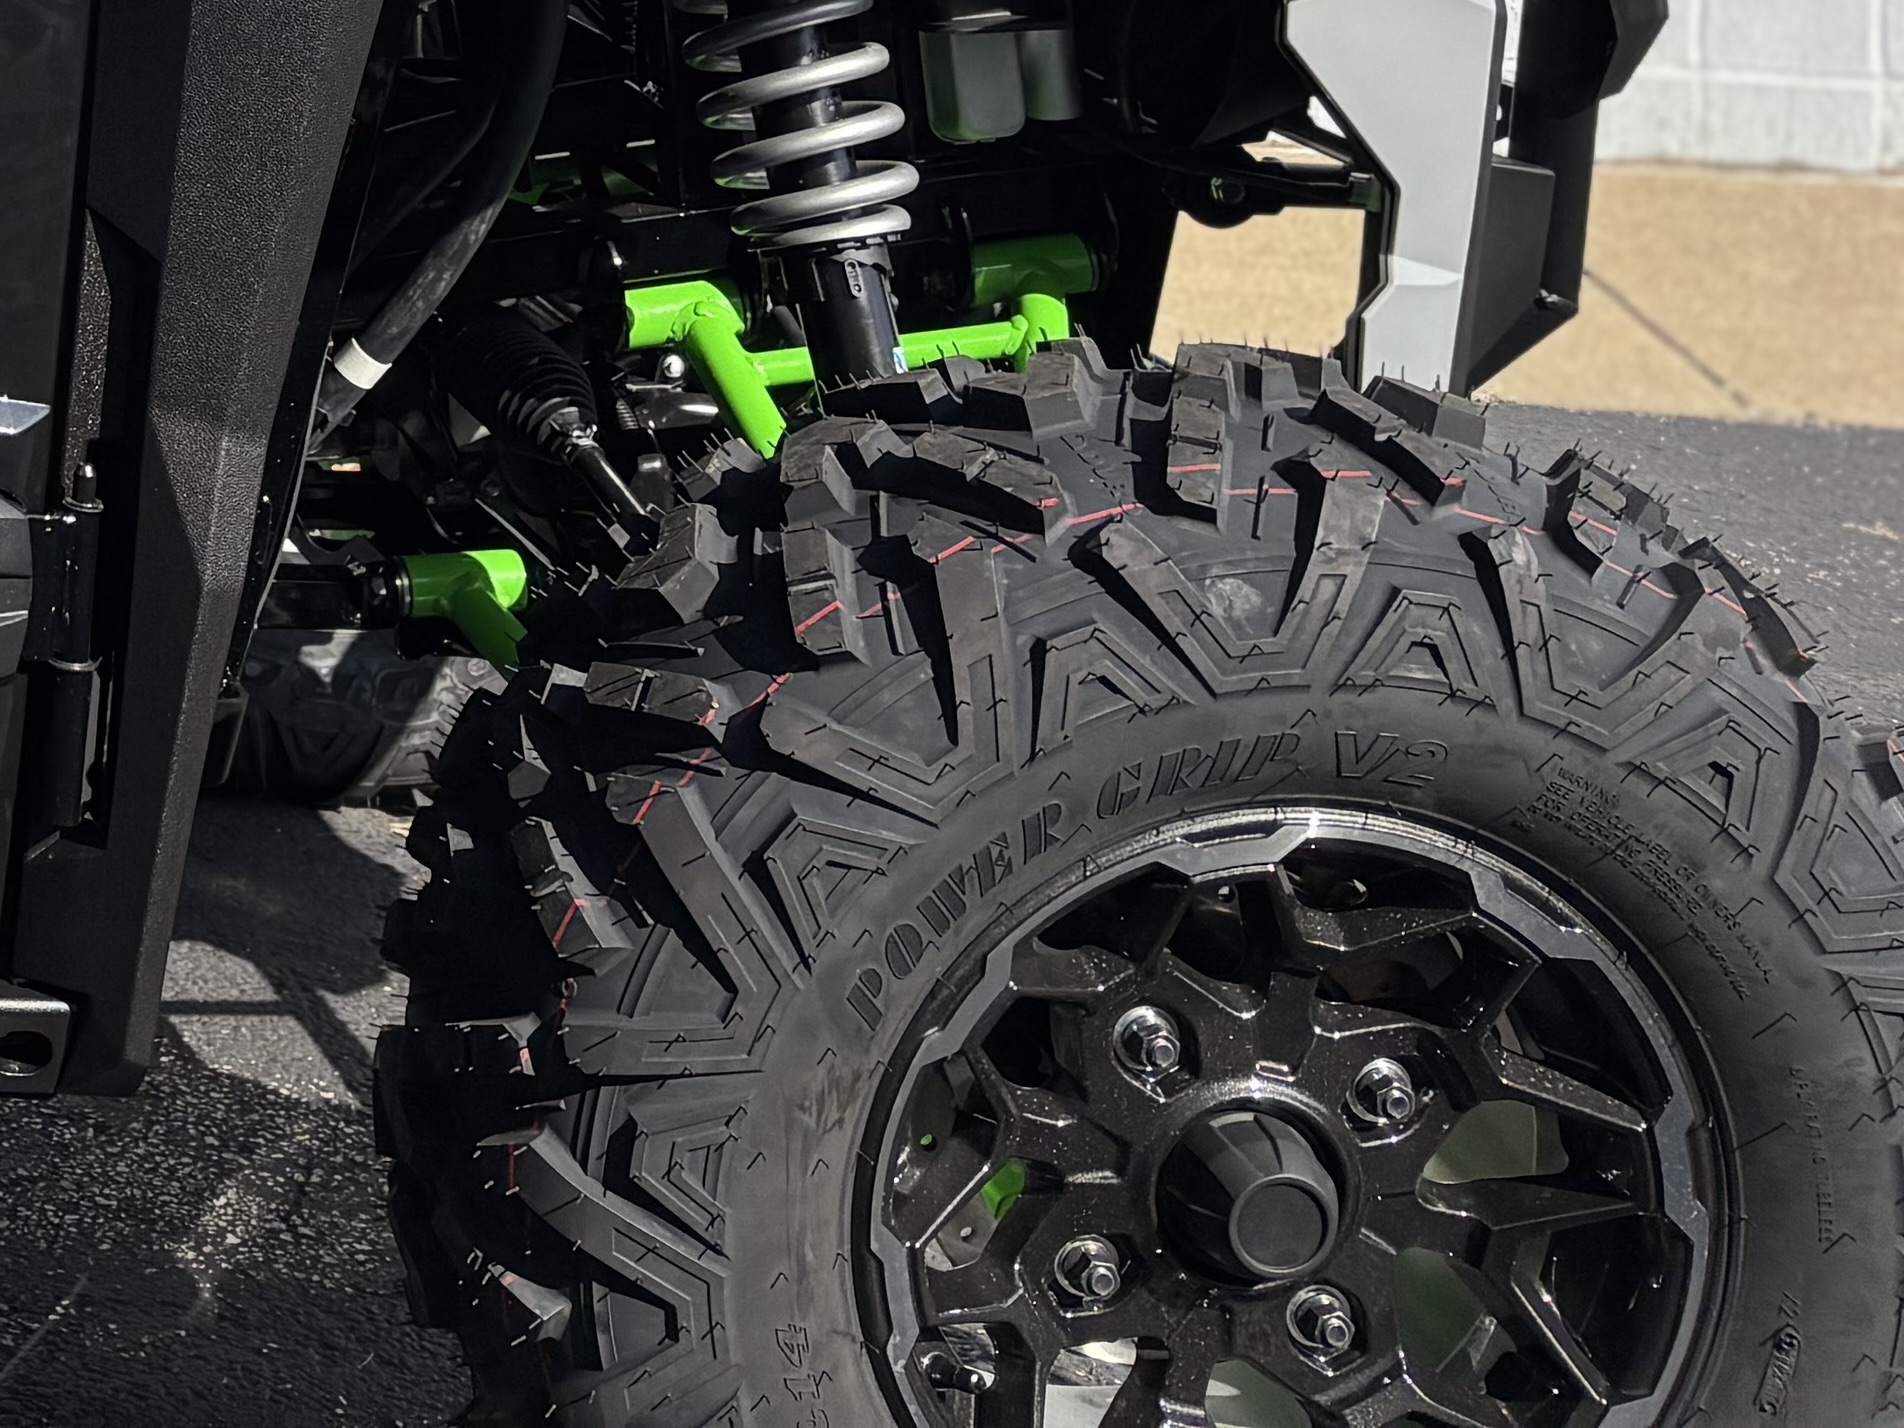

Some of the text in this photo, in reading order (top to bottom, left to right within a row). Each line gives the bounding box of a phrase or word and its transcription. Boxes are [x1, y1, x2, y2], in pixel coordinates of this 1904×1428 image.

[844, 729, 1450, 1031] POWER GRIP V2
